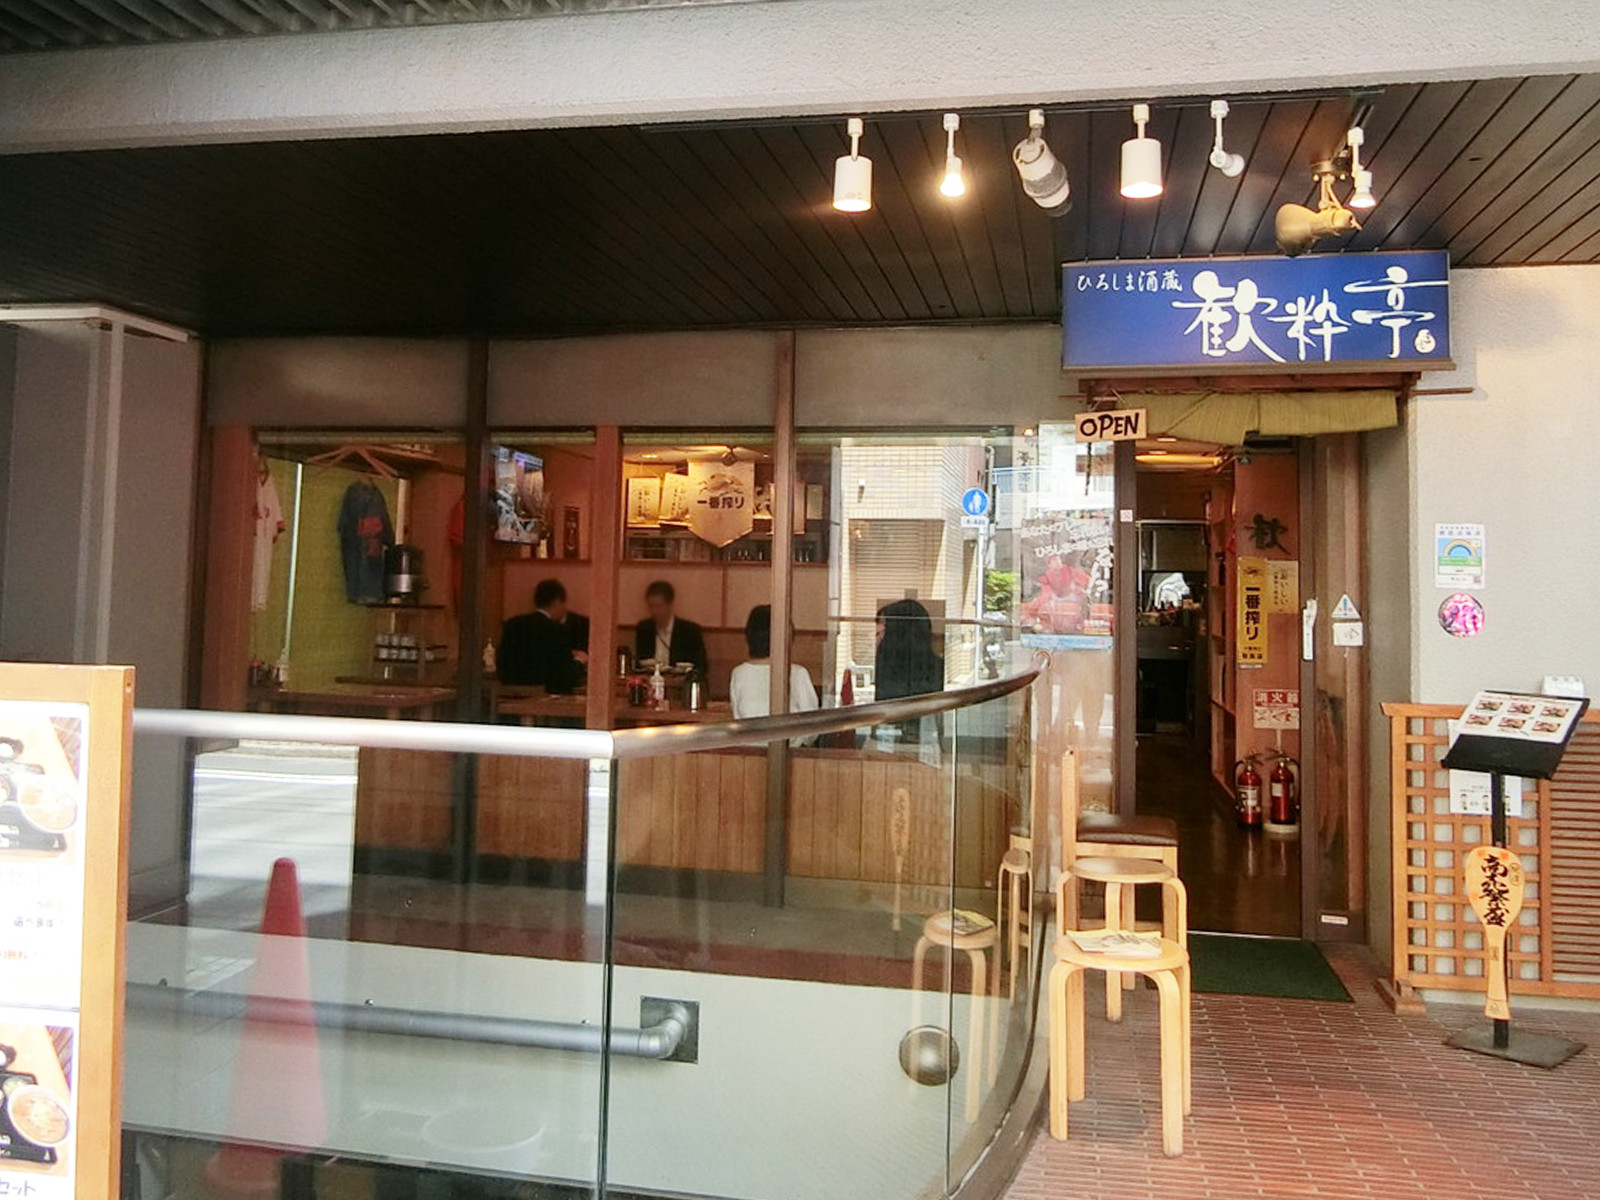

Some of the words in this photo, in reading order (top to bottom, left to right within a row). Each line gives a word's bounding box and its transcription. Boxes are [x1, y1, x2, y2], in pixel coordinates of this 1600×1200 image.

[1077, 269, 1183, 294] ひろしま酒蔵
[1079, 411, 1140, 439] OPEN
[697, 495, 744, 509] 一番搾り
[1245, 587, 1261, 641] 一番搾り
